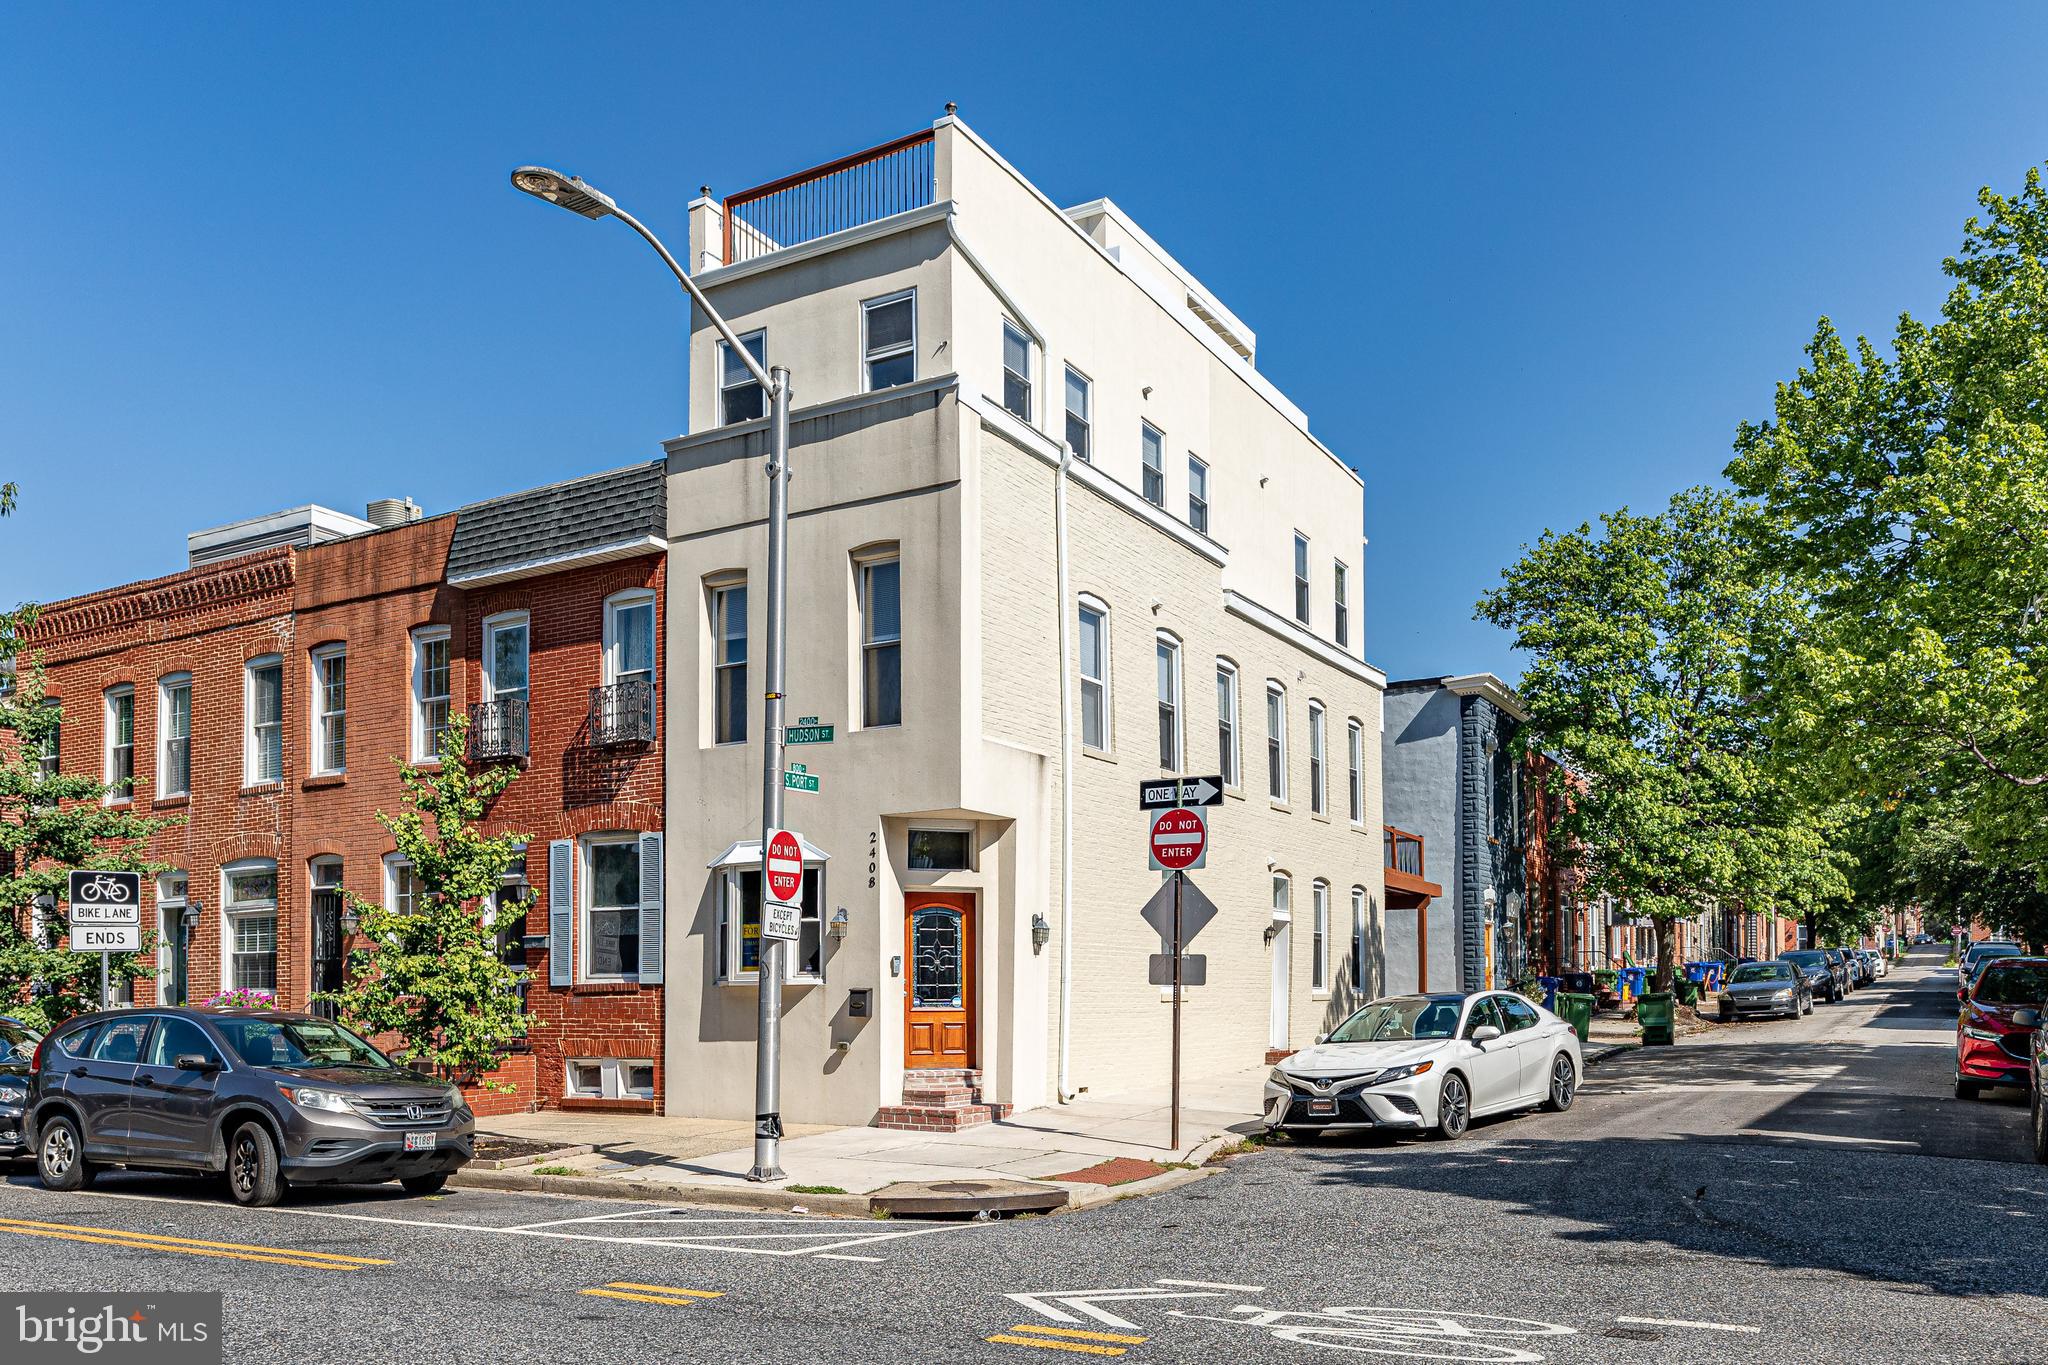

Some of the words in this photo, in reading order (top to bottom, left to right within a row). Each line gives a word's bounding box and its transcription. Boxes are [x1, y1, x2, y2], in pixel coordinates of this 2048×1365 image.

[788, 728, 820, 742] HUDSON
[792, 775, 807, 788] PORT
[1148, 788, 1170, 801] ONE
[1159, 821, 1172, 831] DO
[1179, 819, 1197, 830] NOT
[772, 844, 781, 855] DO
[784, 846, 798, 857] NOT
[1162, 847, 1192, 857] ENTER
[868, 831, 877, 889] 2408
[773, 875, 794, 888] ENTER
[78, 907, 101, 918] BIKE
[104, 908, 132, 919] LANE
[773, 908, 793, 921] EXCEPT
[743, 927, 759, 936] FOR
[769, 922, 795, 936] BICYCLES
[86, 932, 125, 945] ENDS
